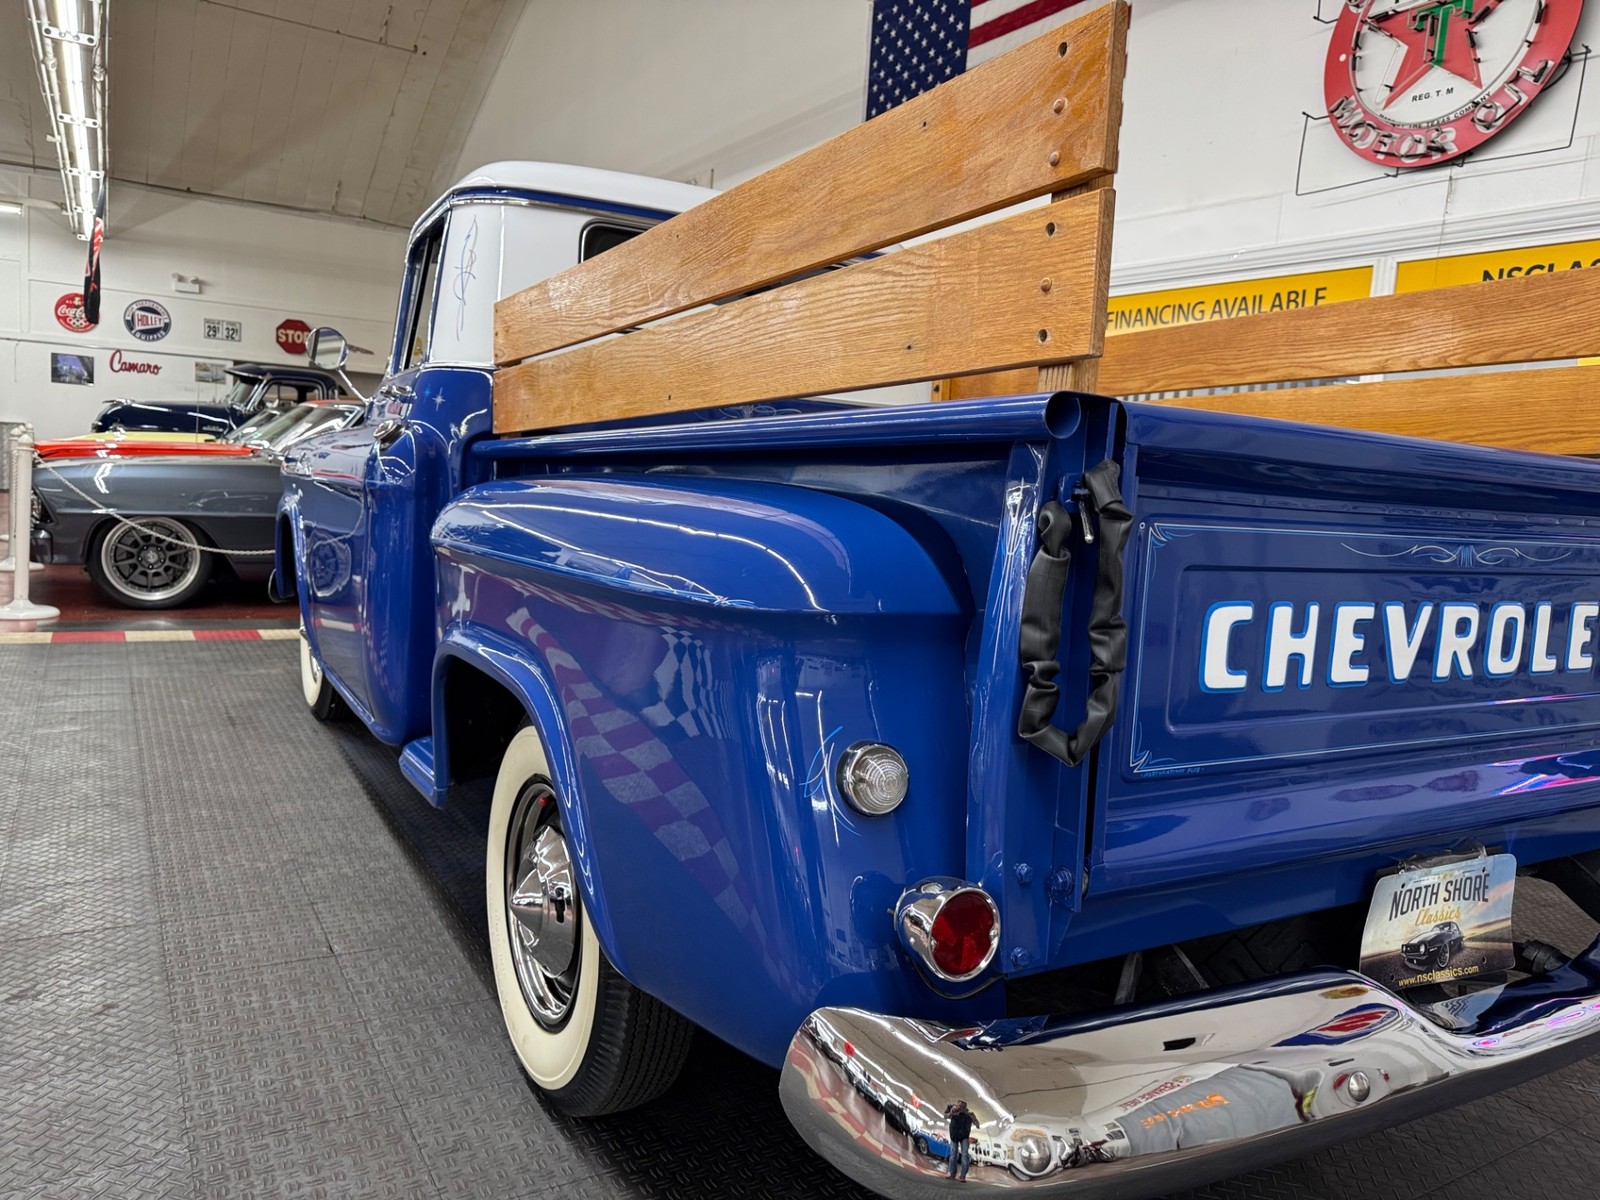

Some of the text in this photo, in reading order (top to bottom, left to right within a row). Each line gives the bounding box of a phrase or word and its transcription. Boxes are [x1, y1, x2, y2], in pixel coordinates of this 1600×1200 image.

[1106, 286, 1328, 330] FINANCING AVAILABLE
[137, 313, 162, 328] HOLLEY
[109, 349, 162, 375] Camaro
[1389, 873, 1490, 921] NORTH SHORE
[1414, 906, 1462, 926] Classics
[1398, 965, 1479, 987] www.nsclassics.com
